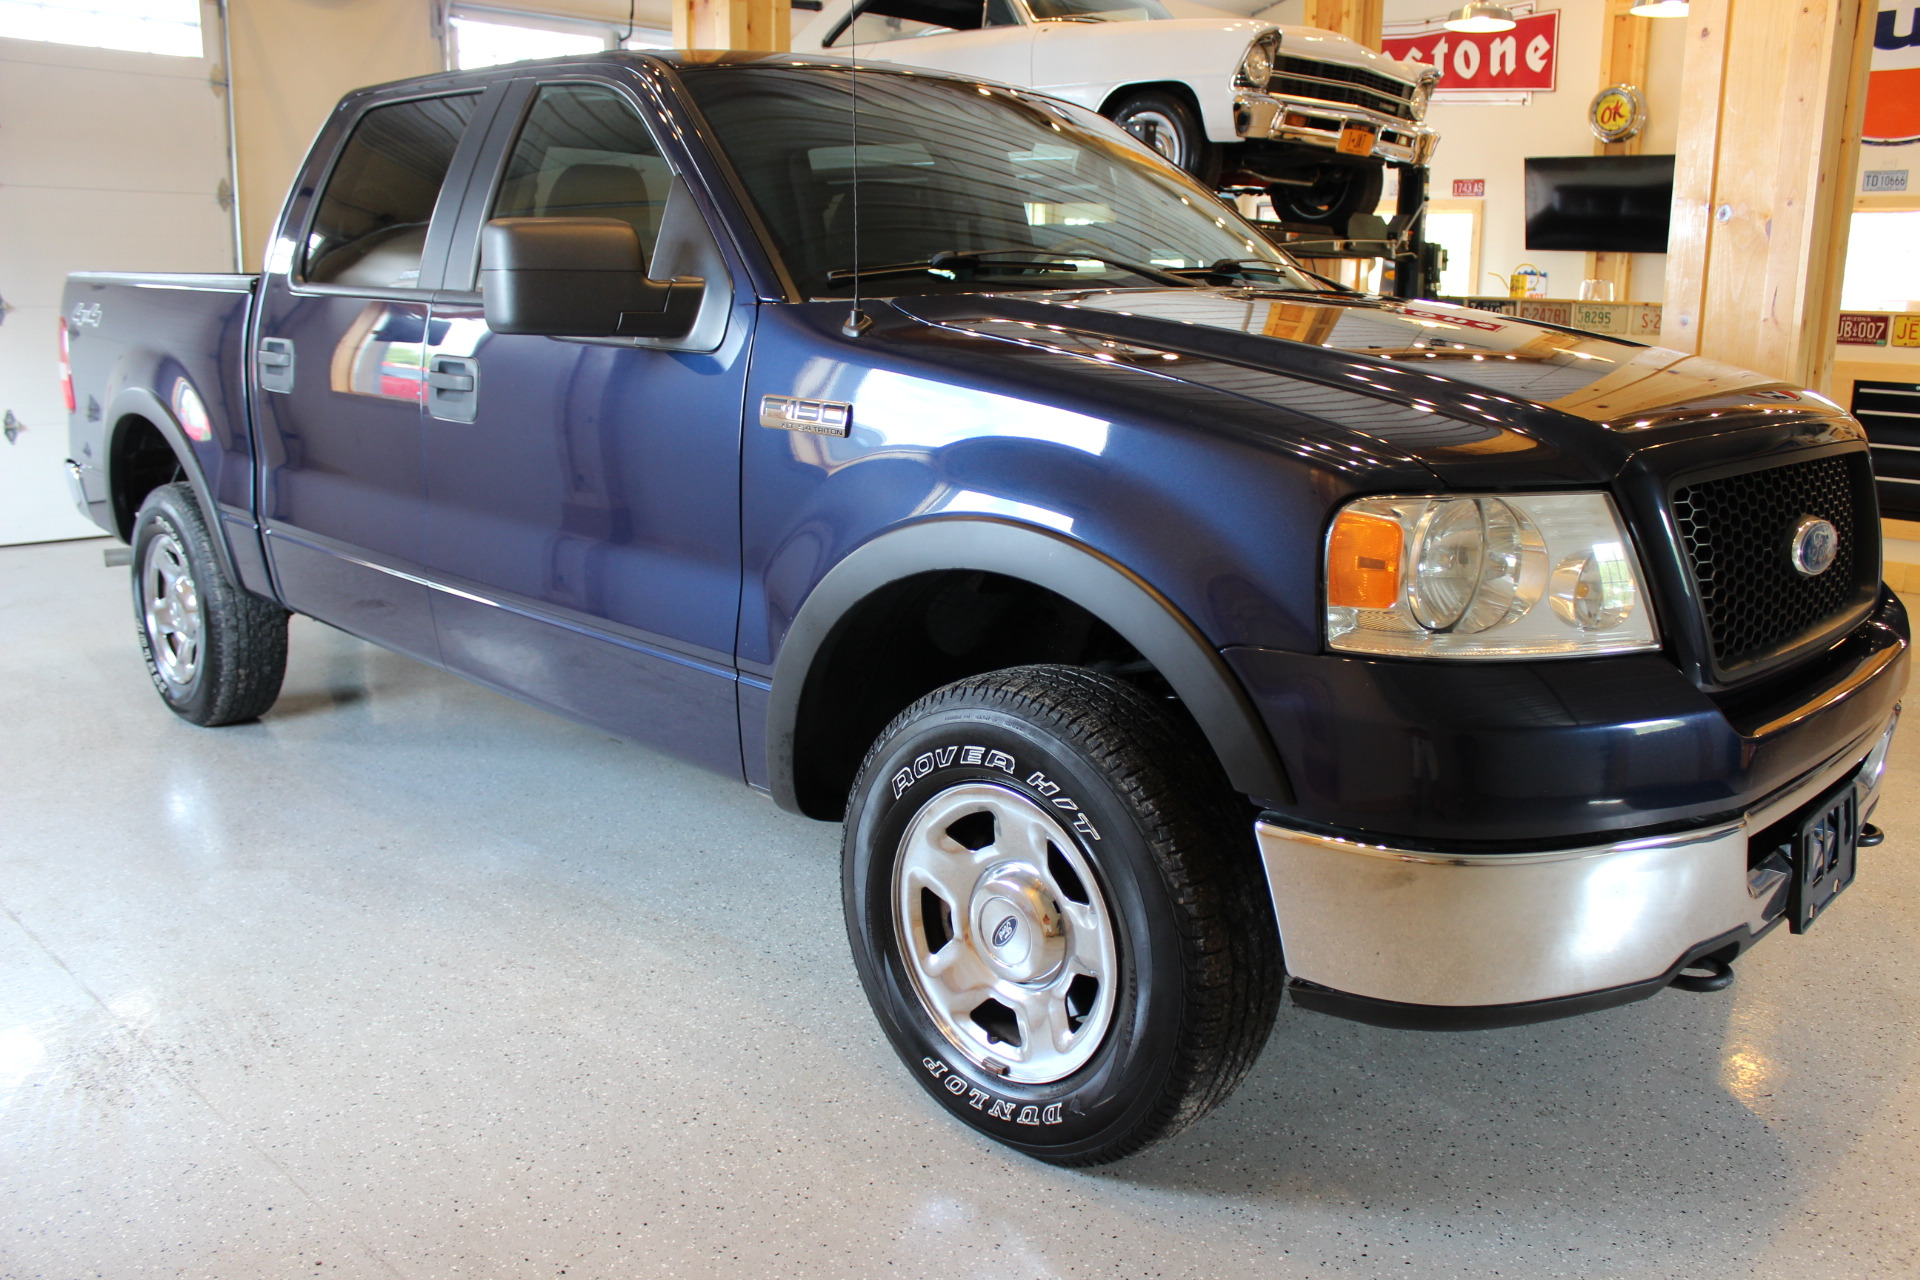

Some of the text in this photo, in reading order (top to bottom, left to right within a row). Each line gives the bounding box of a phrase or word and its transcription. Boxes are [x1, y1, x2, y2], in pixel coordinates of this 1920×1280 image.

[1600, 99, 1625, 125] OK
[71, 302, 103, 328] 4x4
[813, 426, 843, 436] TRITON
[891, 745, 1016, 800] ROVER
[922, 1056, 1064, 1127] DUNLOP
